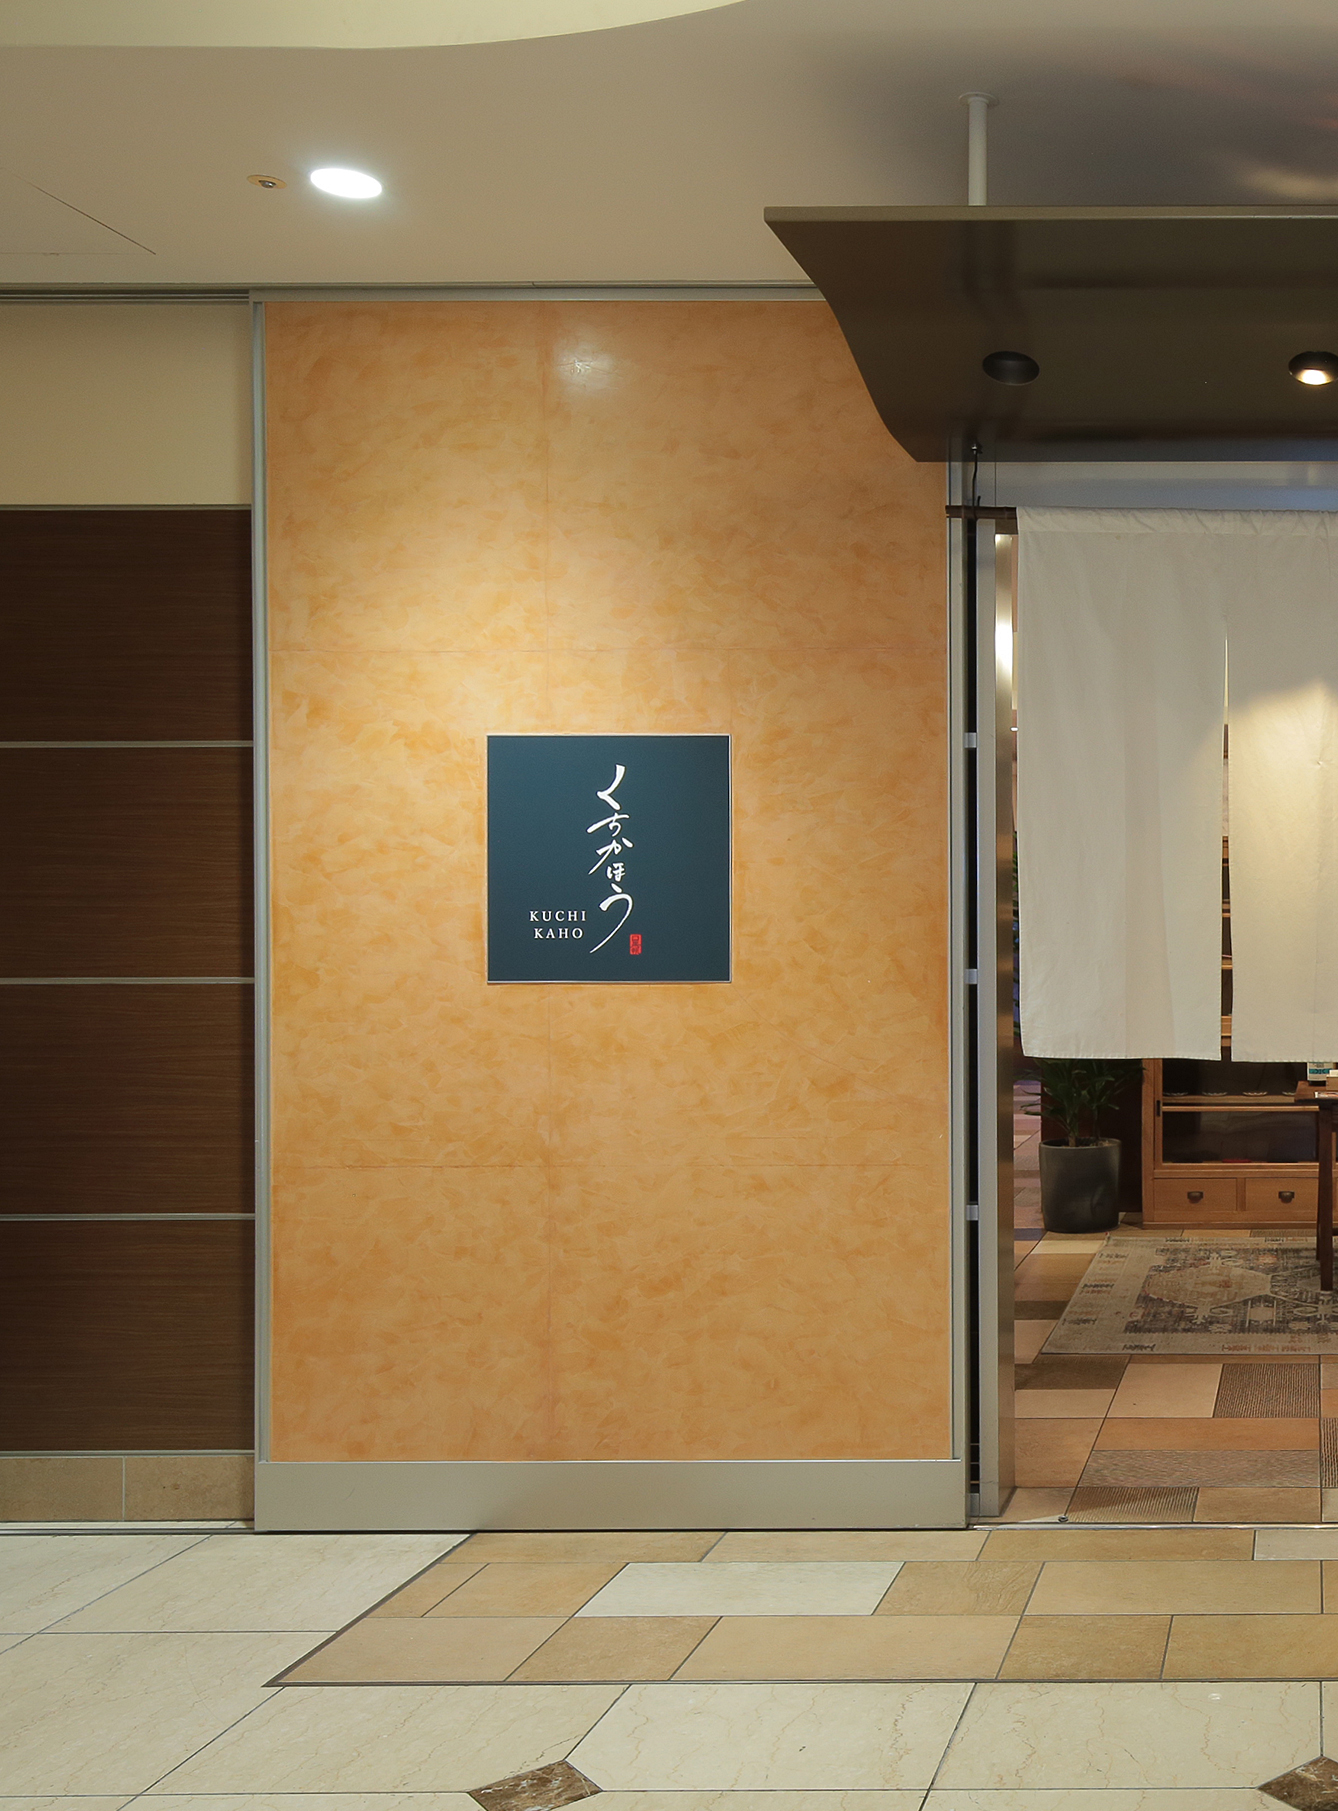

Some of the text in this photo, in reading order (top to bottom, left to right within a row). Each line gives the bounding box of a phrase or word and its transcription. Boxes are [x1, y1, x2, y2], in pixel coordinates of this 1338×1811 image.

[586, 764, 634, 954] くちかほう
[529, 910, 587, 922] KUCHI
[534, 927, 584, 939] KAHO
